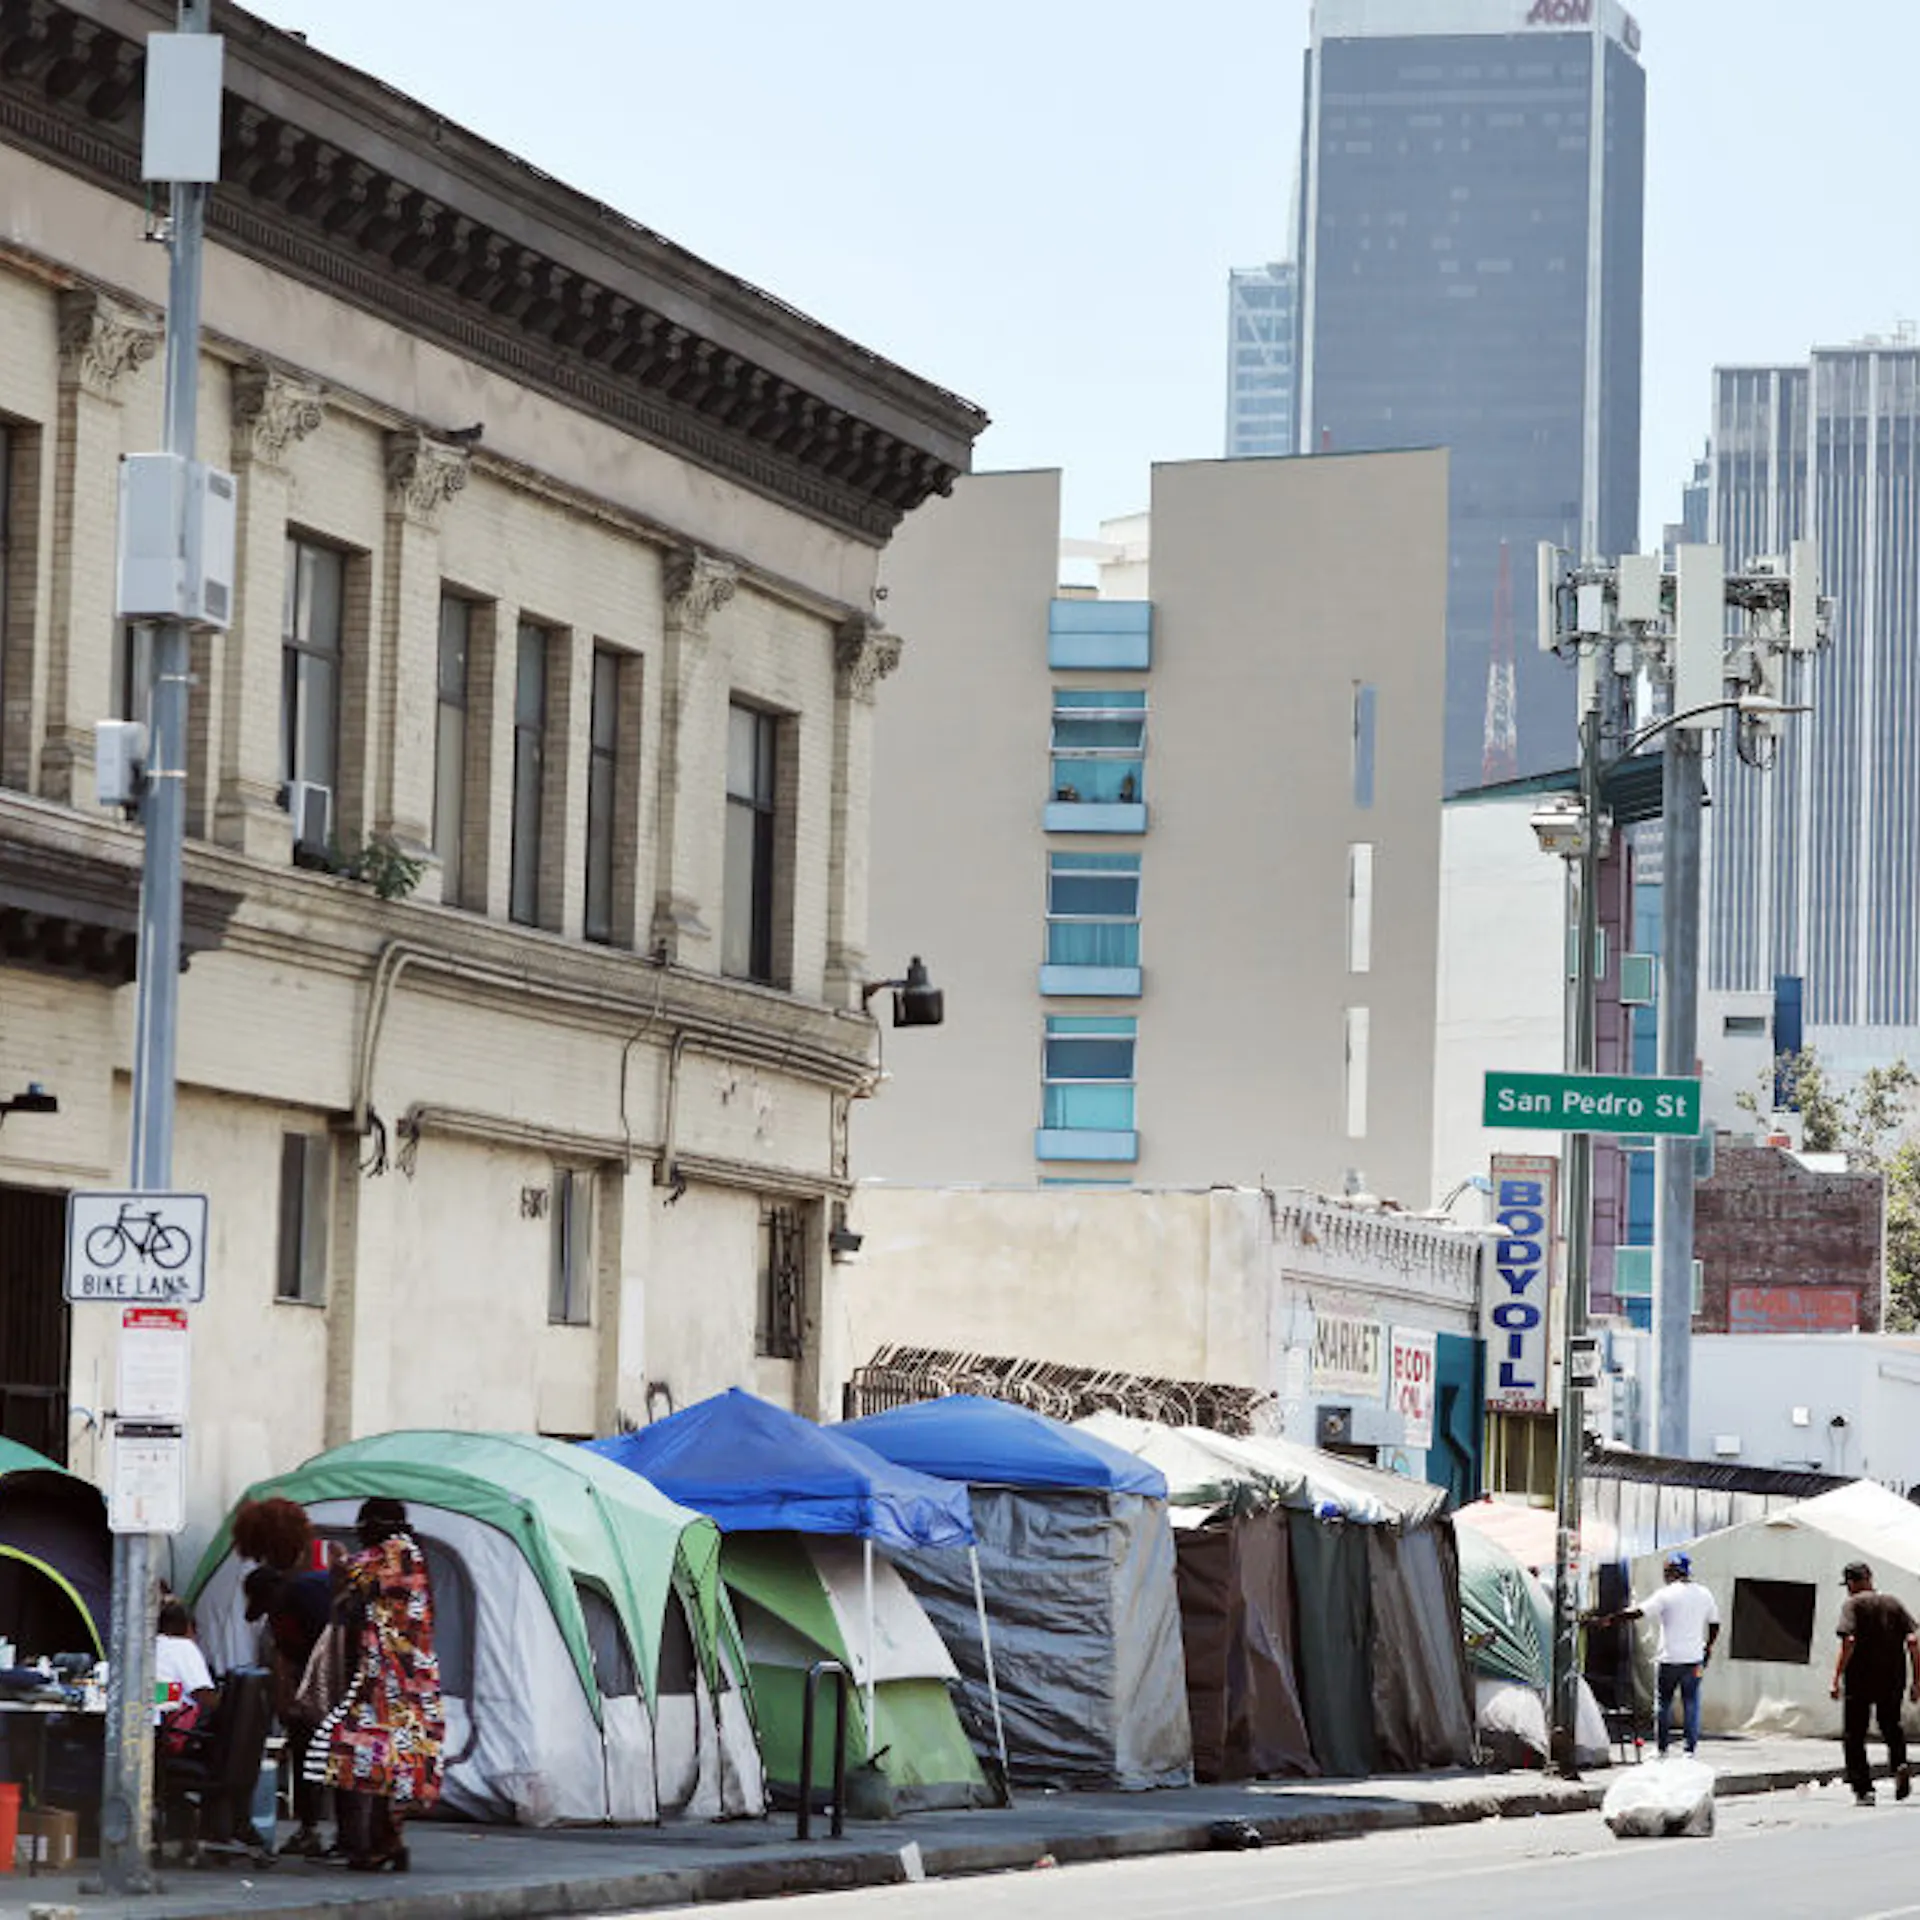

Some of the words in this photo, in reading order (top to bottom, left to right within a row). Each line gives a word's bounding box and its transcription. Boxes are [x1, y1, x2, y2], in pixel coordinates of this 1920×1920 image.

[1498, 1088, 1551, 1113] San
[1563, 1090, 1644, 1117] Pedro
[1655, 1094, 1687, 1118] St
[1495, 1180, 1545, 1295] BODY
[82, 1274, 126, 1294] BIKE
[1314, 1316, 1381, 1375] MARKET
[1492, 1302, 1542, 1388] OIL
